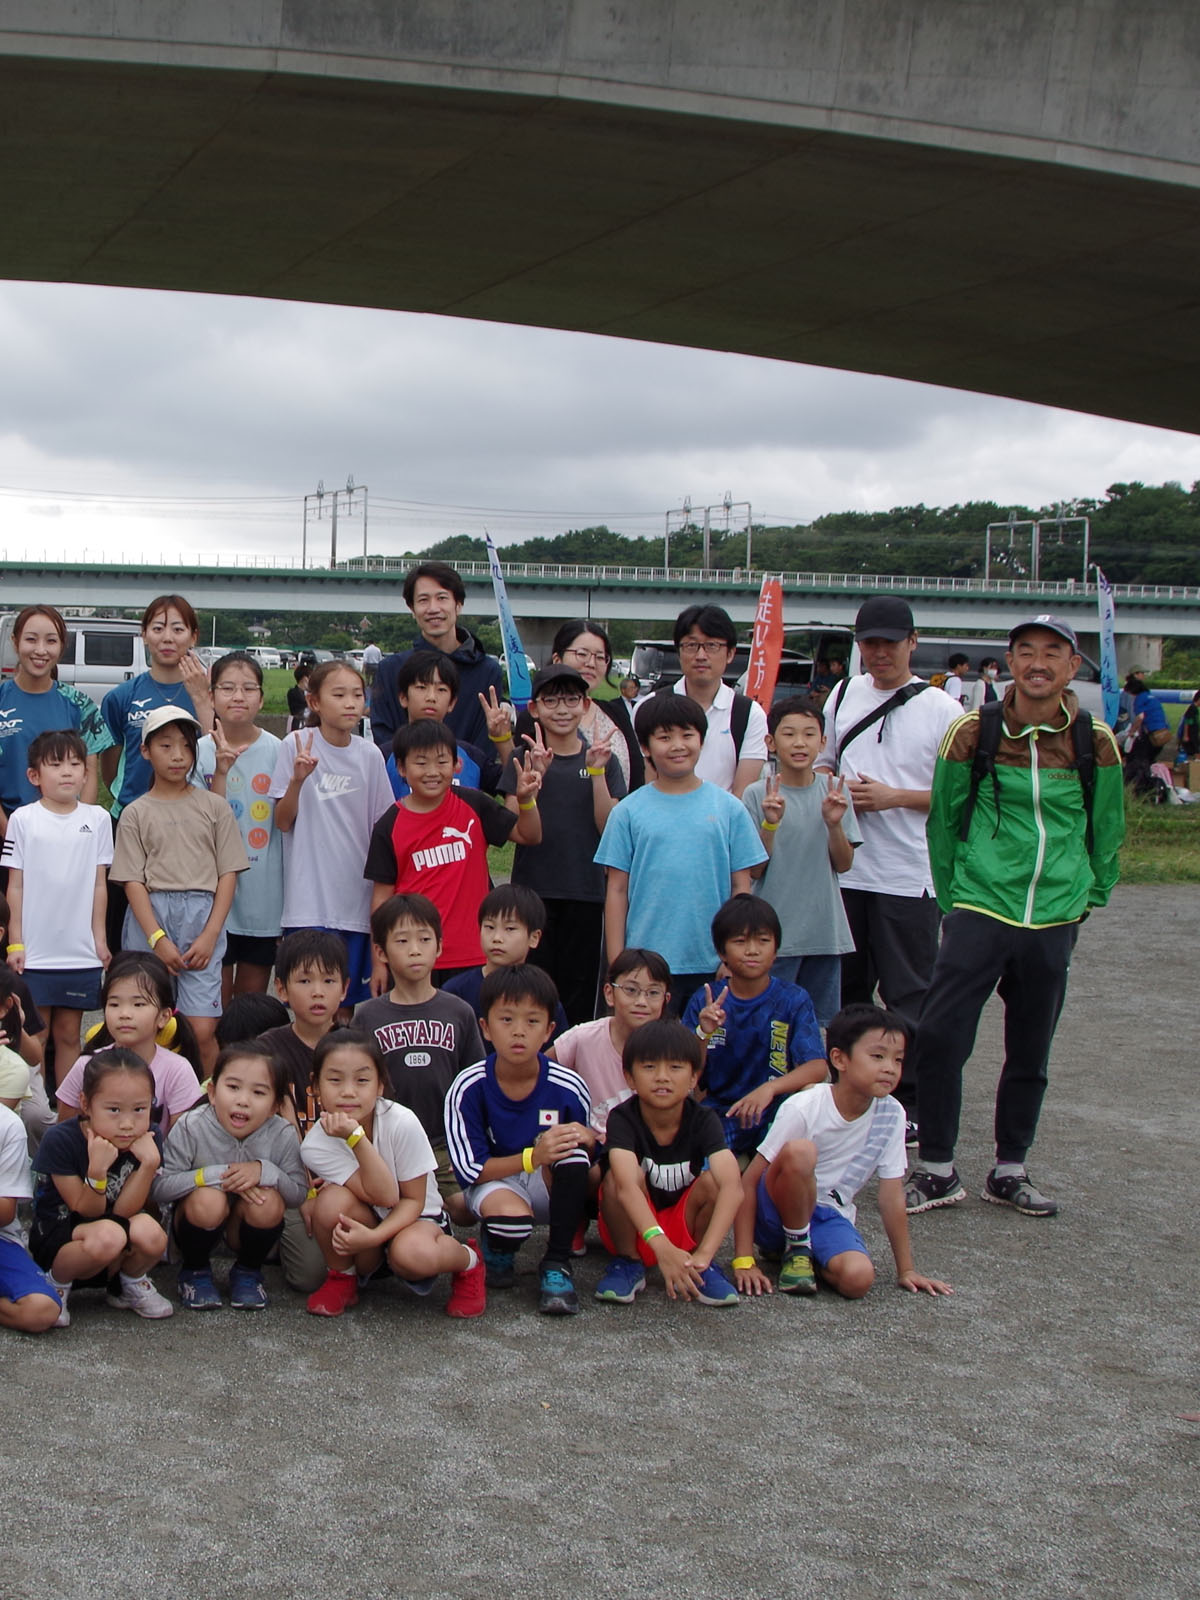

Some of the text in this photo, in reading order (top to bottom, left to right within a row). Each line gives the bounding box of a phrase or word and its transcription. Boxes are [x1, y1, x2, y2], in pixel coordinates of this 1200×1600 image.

[320, 773, 352, 793] NIKE
[411, 840, 466, 872] PUMA
[374, 1020, 456, 1055] NEVADA
[408, 1055, 427, 1065] 1864
